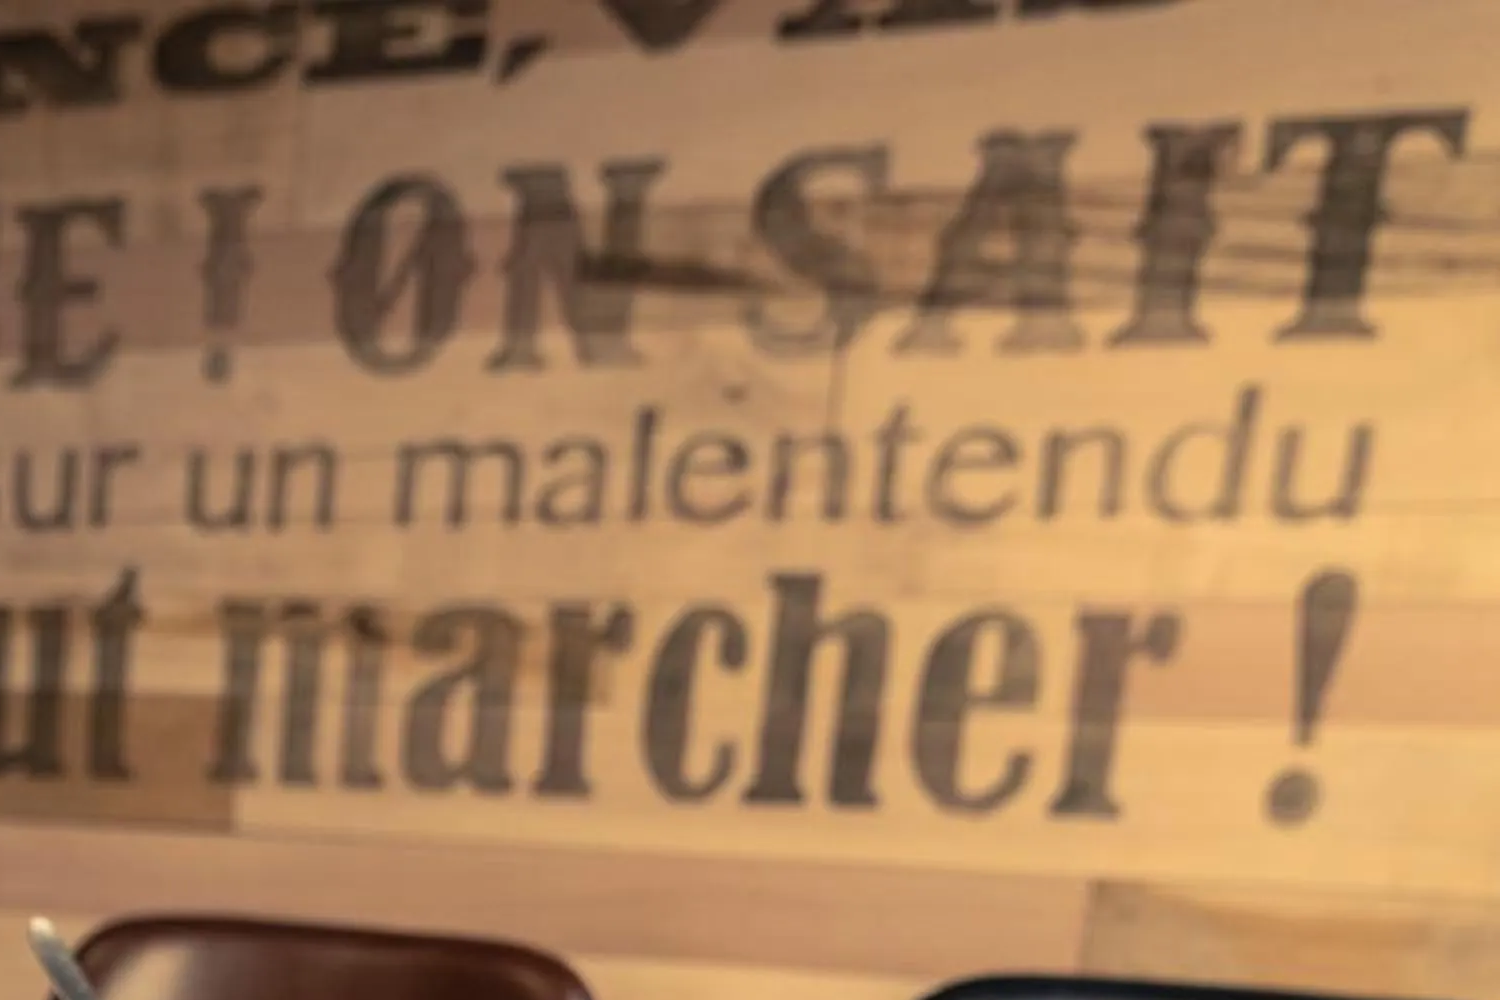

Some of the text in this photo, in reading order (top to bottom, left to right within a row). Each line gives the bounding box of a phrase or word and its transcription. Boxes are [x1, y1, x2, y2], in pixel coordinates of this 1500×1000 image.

[198, 186, 264, 386] !
[326, 156, 670, 379] ON
[743, 106, 1474, 360] SAIT
[184, 438, 340, 534] un
[394, 383, 1374, 534] malentendu
[203, 572, 1184, 822] marcher
[1261, 567, 1360, 827] !
